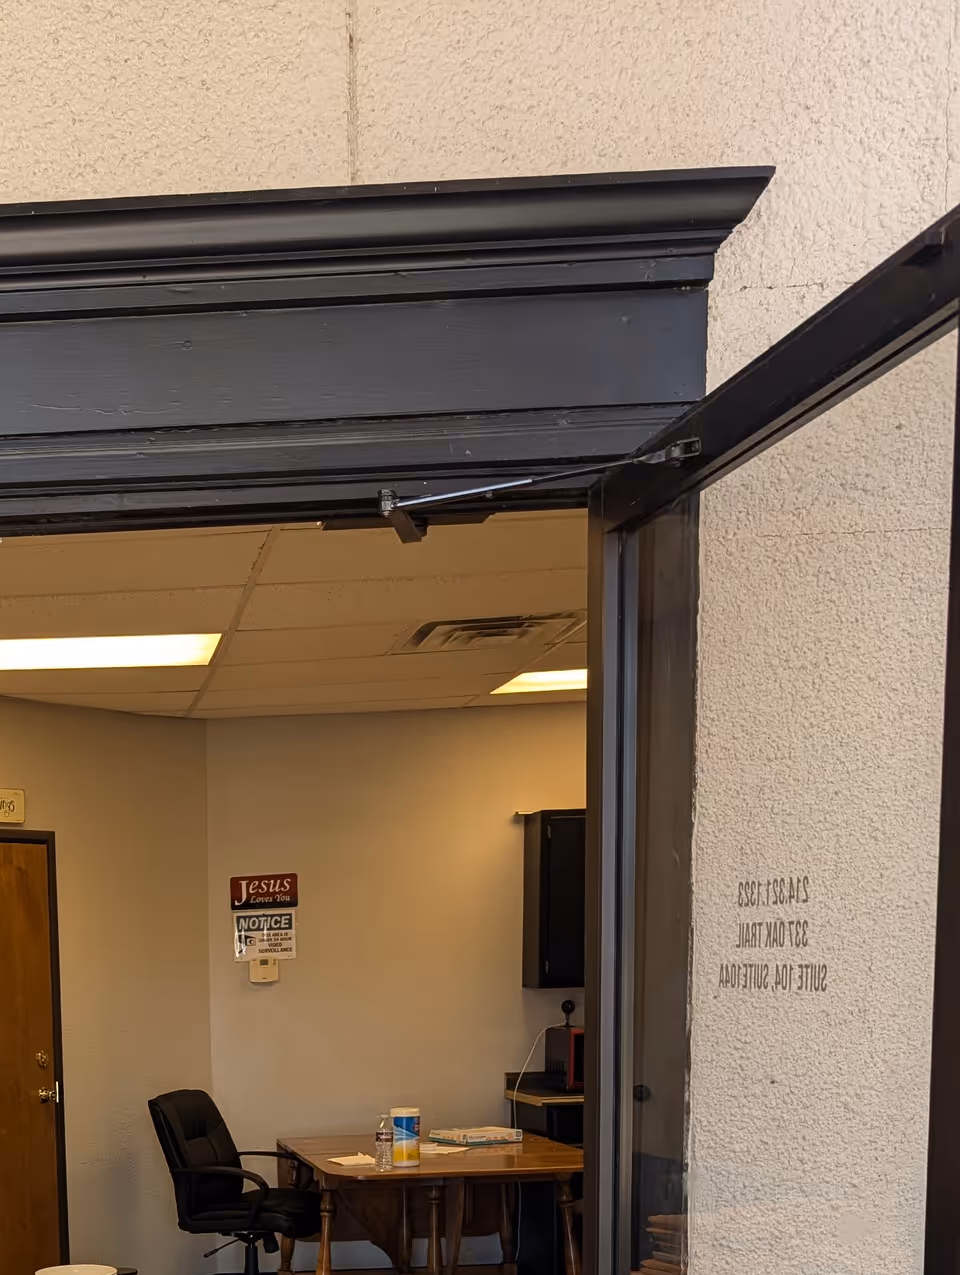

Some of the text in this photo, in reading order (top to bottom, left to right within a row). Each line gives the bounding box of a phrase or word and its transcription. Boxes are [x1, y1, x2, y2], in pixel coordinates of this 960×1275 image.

[235, 878, 291, 905] Jesus
[249, 893, 291, 904] Loves You
[239, 916, 290, 930] NOTICE
